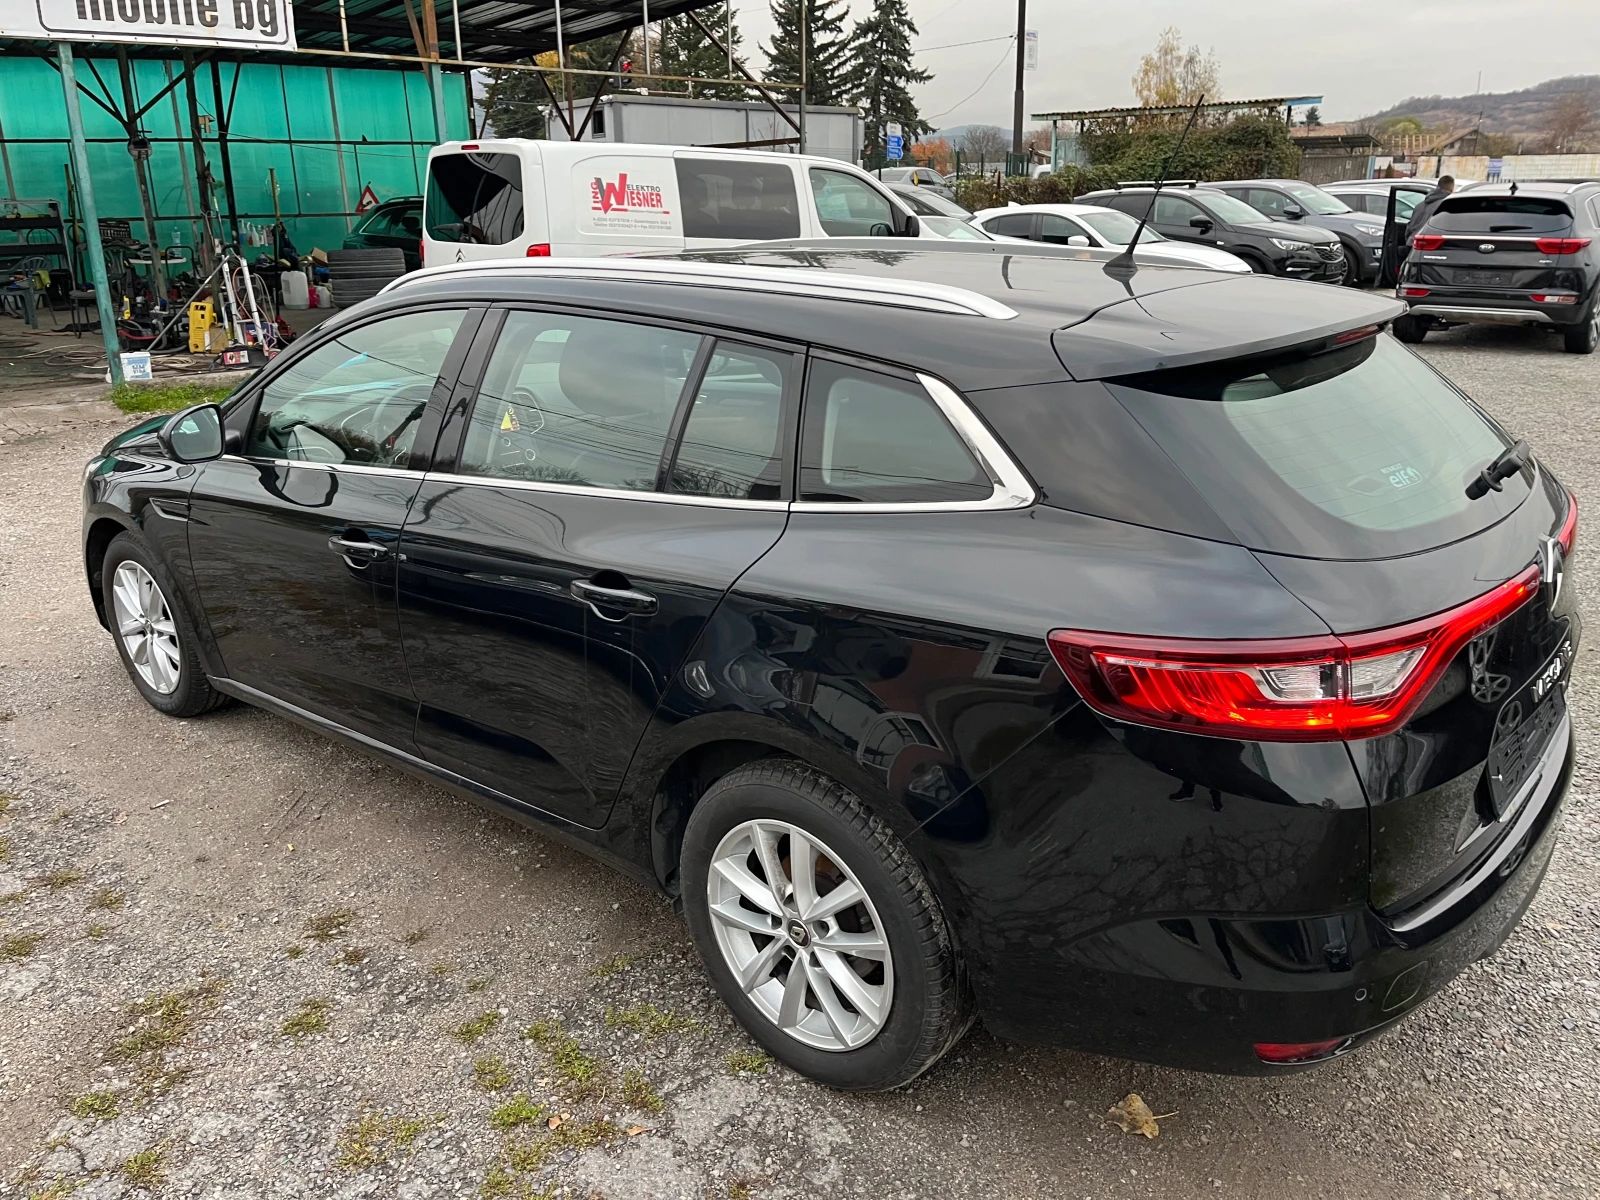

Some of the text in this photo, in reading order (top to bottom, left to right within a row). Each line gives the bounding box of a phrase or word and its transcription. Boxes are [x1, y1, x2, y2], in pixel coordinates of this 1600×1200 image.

[626, 184, 661, 193] ELEKTRO
[1389, 470, 1410, 488] elf
[1530, 640, 1573, 703] MEGANE
